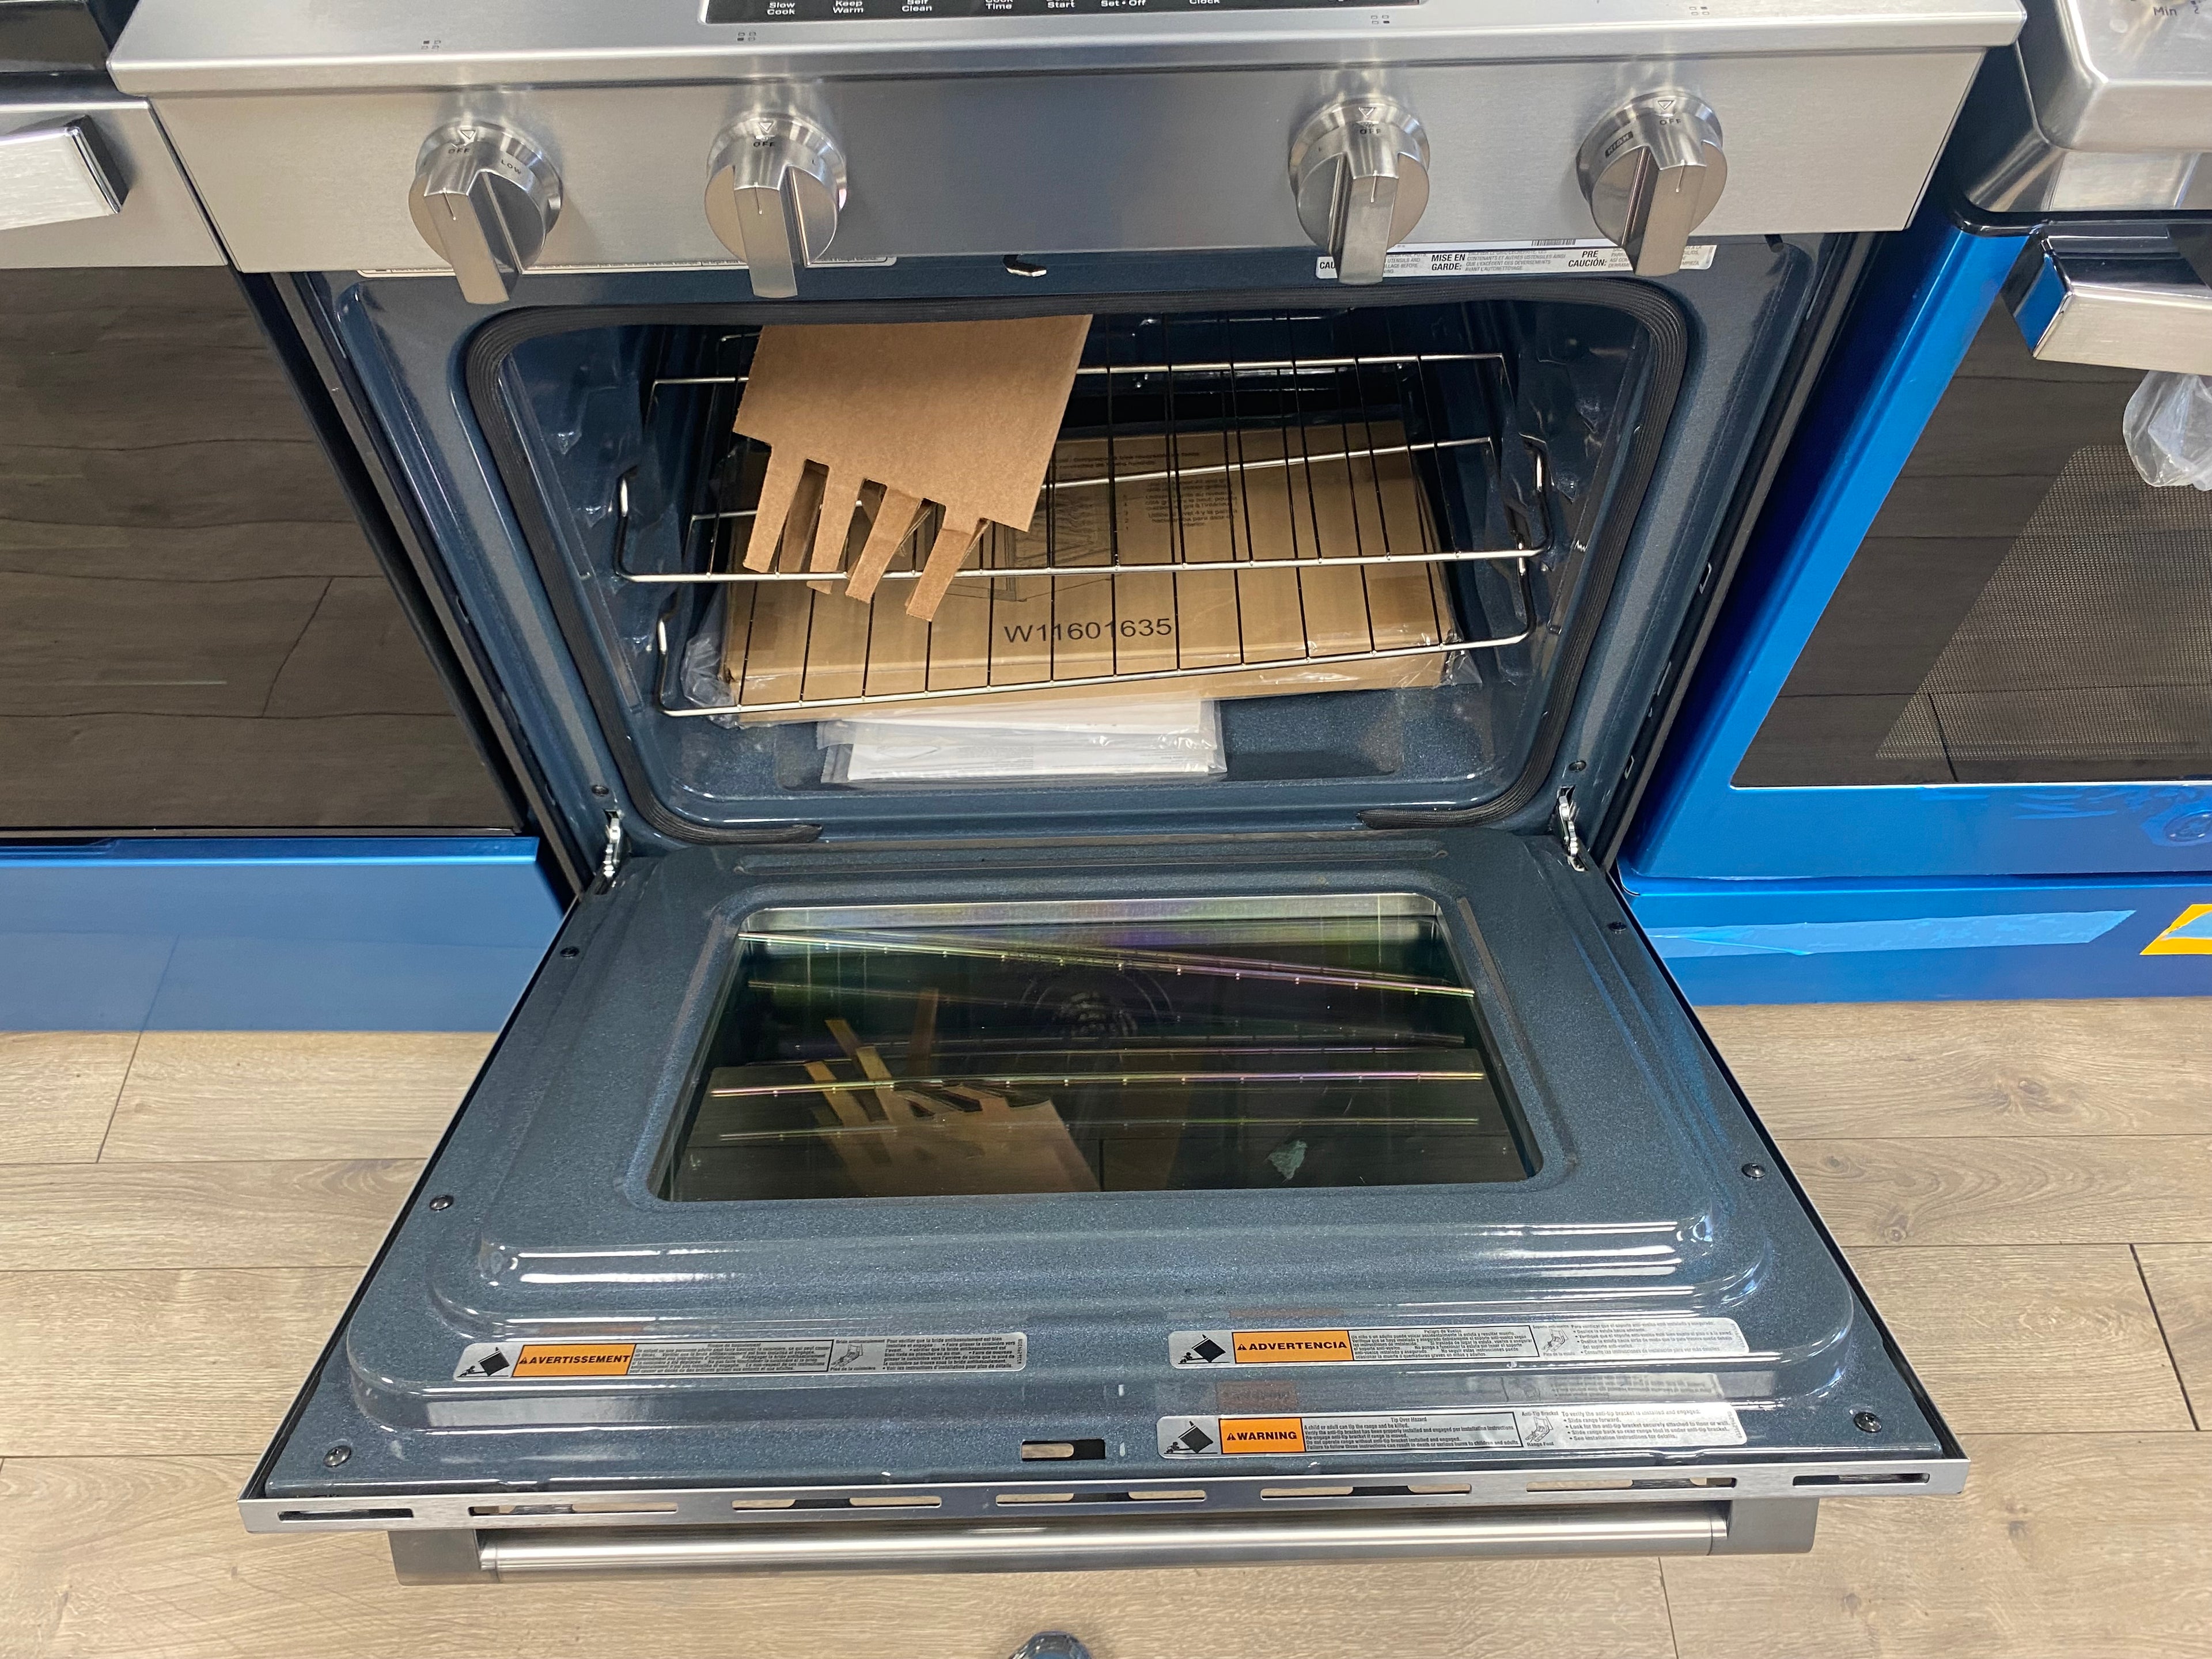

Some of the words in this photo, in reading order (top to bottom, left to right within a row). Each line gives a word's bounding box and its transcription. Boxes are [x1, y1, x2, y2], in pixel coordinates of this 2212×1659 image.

[2153, 7, 2177, 16] Min
[501, 159, 521, 175] LOW
[1569, 257, 1607, 267] CAUCIÓN:
[1004, 618, 1172, 643] W11601635
[1249, 1341, 1347, 1350] ADVERTENCIA
[529, 1354, 631, 1364] AVERTISSEMENT
[1237, 1431, 1297, 1440] WARNING
